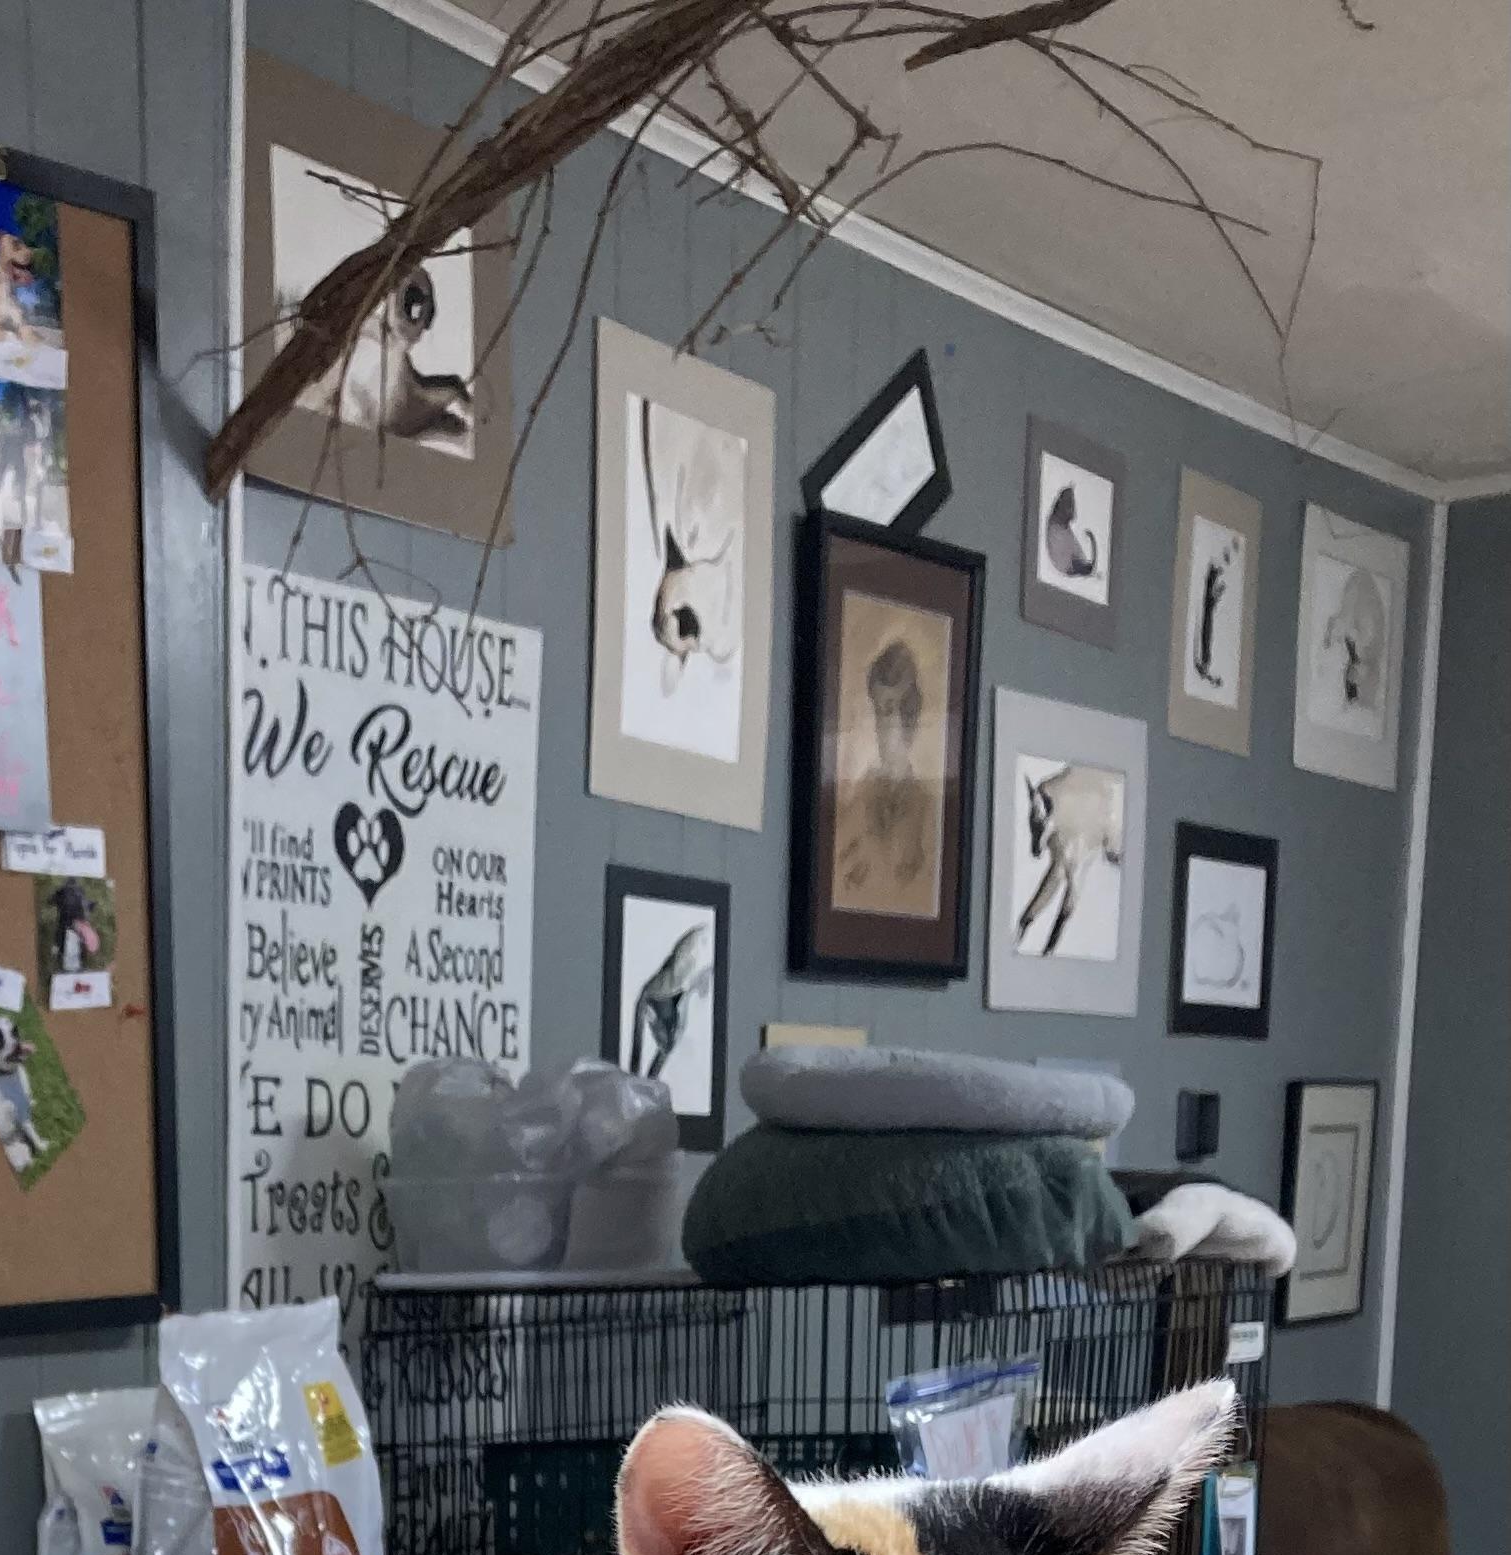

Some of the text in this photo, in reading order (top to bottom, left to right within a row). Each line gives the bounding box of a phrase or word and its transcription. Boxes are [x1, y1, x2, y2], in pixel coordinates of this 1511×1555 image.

[267, 574, 369, 679] THIS
[383, 612, 530, 711] HOUSE
[243, 678, 506, 818] We Rescue
[432, 848, 507, 886] ON OUR
[435, 880, 504, 919] Hearts
[246, 908, 339, 997] Believe
[359, 922, 384, 1056] DESERVES
[405, 921, 504, 990] A Second
[386, 990, 519, 1063] CHANCE
[305, 1076, 370, 1139] DO
[241, 1149, 360, 1236] Treats
